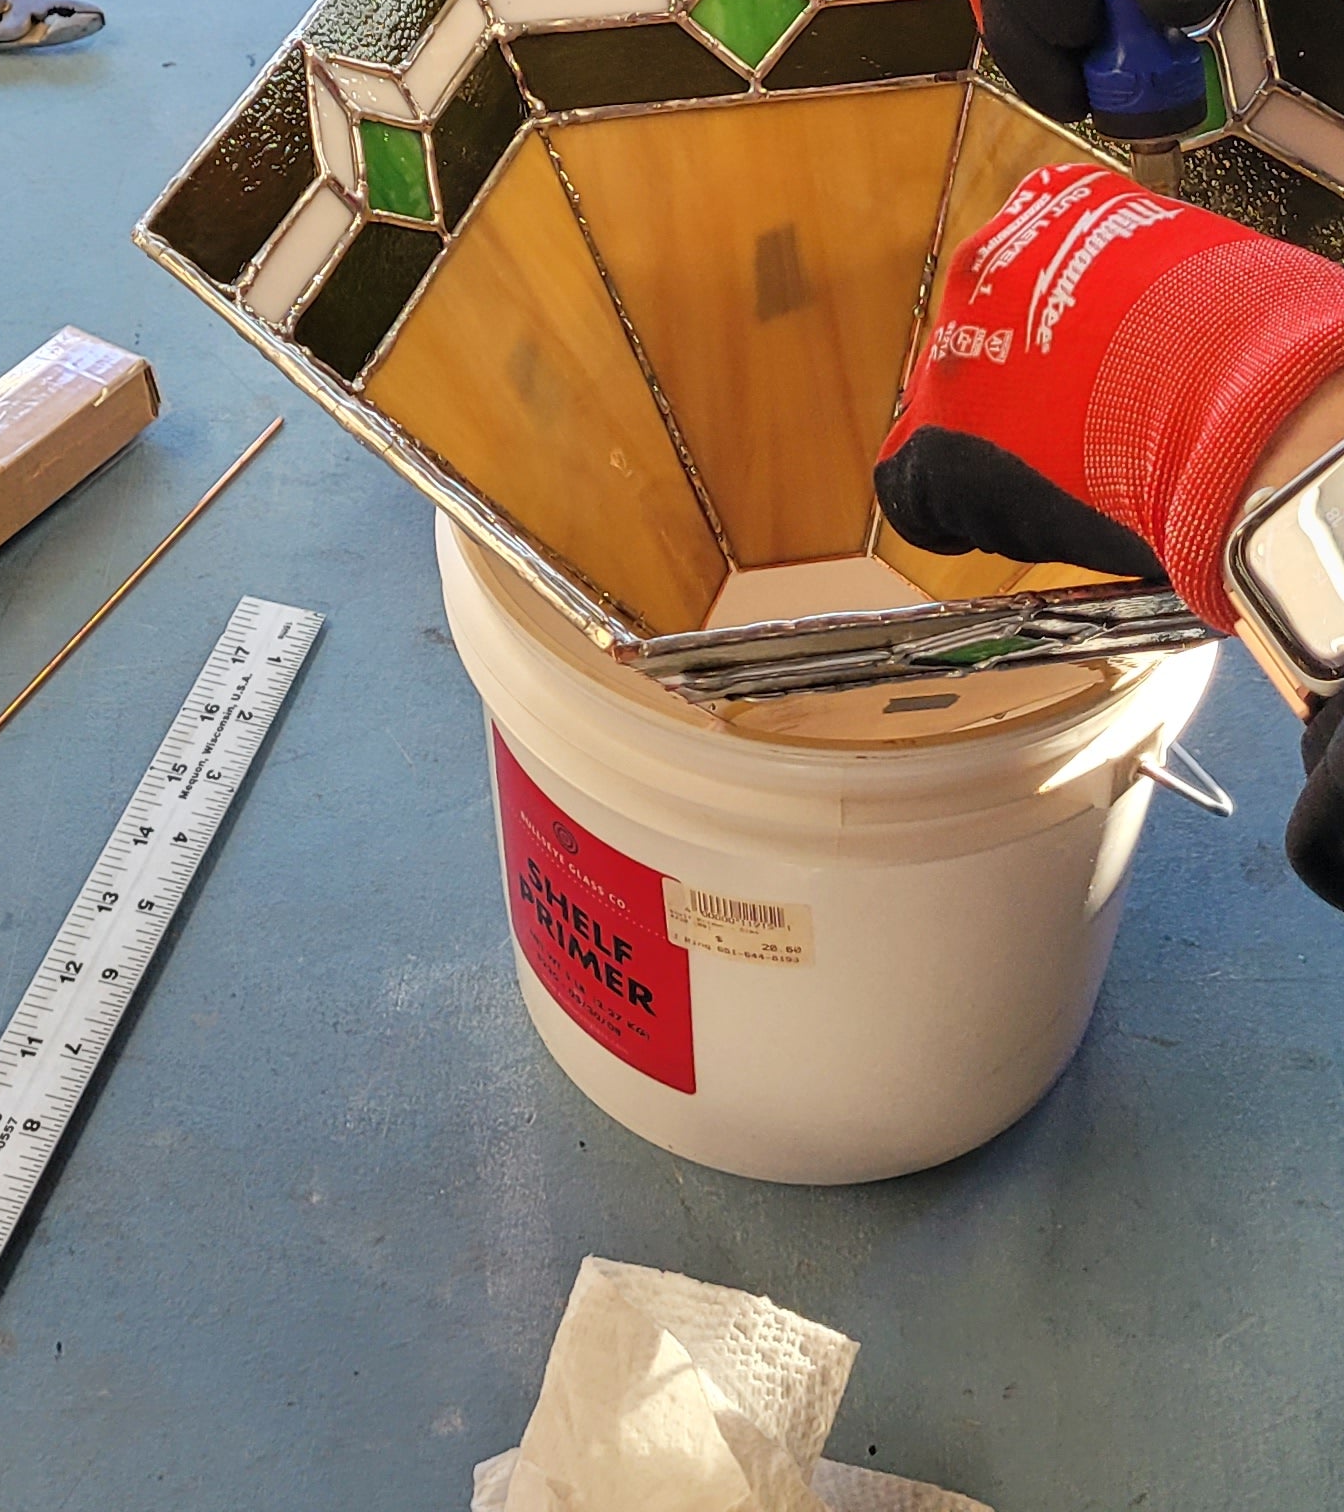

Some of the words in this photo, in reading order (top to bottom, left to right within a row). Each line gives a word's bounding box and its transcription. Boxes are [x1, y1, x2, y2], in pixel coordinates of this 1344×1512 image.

[1052, 187, 1092, 217] CUT
[989, 219, 1051, 274] LEVEL
[1036, 197, 1185, 355] Milwaukee
[230, 646, 250, 666] 17
[267, 655, 283, 663] 1
[199, 703, 220, 723] 16
[236, 709, 254, 722] 2
[178, 752, 208, 801] Mequon,
[201, 703, 238, 755] Wisconsin,
[230, 672, 254, 702] U.S.A.
[167, 762, 188, 783] 15
[206, 768, 223, 782] 3
[132, 825, 155, 847] 14
[172, 831, 189, 844] 4
[519, 810, 565, 866] BULLSEYE
[568, 862, 605, 897] GLASS
[96, 891, 119, 913] 13
[137, 897, 155, 912] 5
[527, 857, 633, 966] SHELF
[519, 872, 657, 1017] PRIMER
[59, 959, 84, 984] 12
[20, 1036, 44, 1058] 11
[64, 1042, 83, 1056] 7
[22, 1117, 42, 1133] 8
